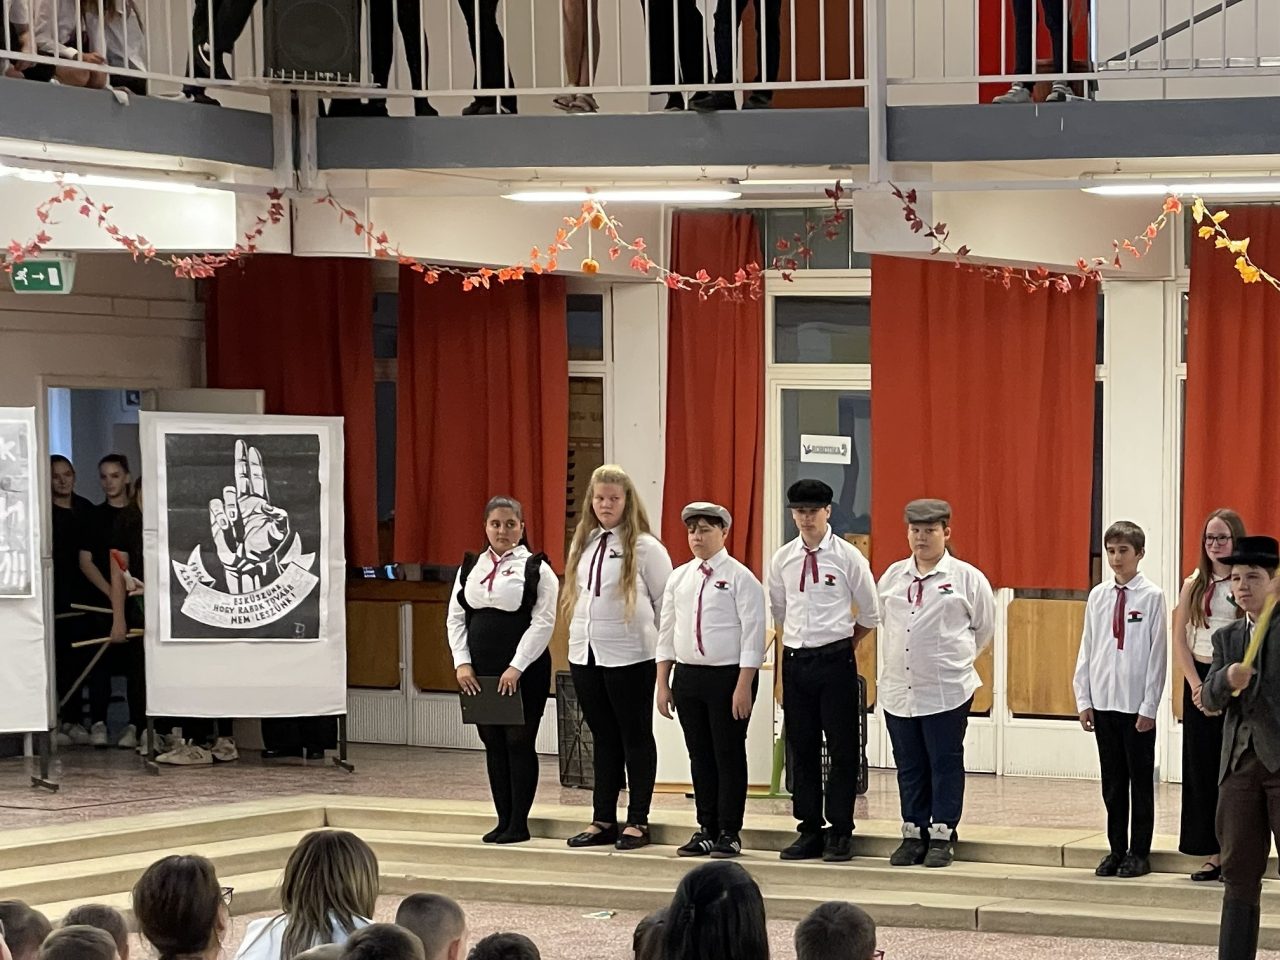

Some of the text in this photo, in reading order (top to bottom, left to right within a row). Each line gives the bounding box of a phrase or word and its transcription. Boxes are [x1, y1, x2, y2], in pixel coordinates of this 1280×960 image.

[213, 604, 235, 614] HOGY
[238, 603, 265, 614] RABOK
[231, 615, 250, 624] NEM
